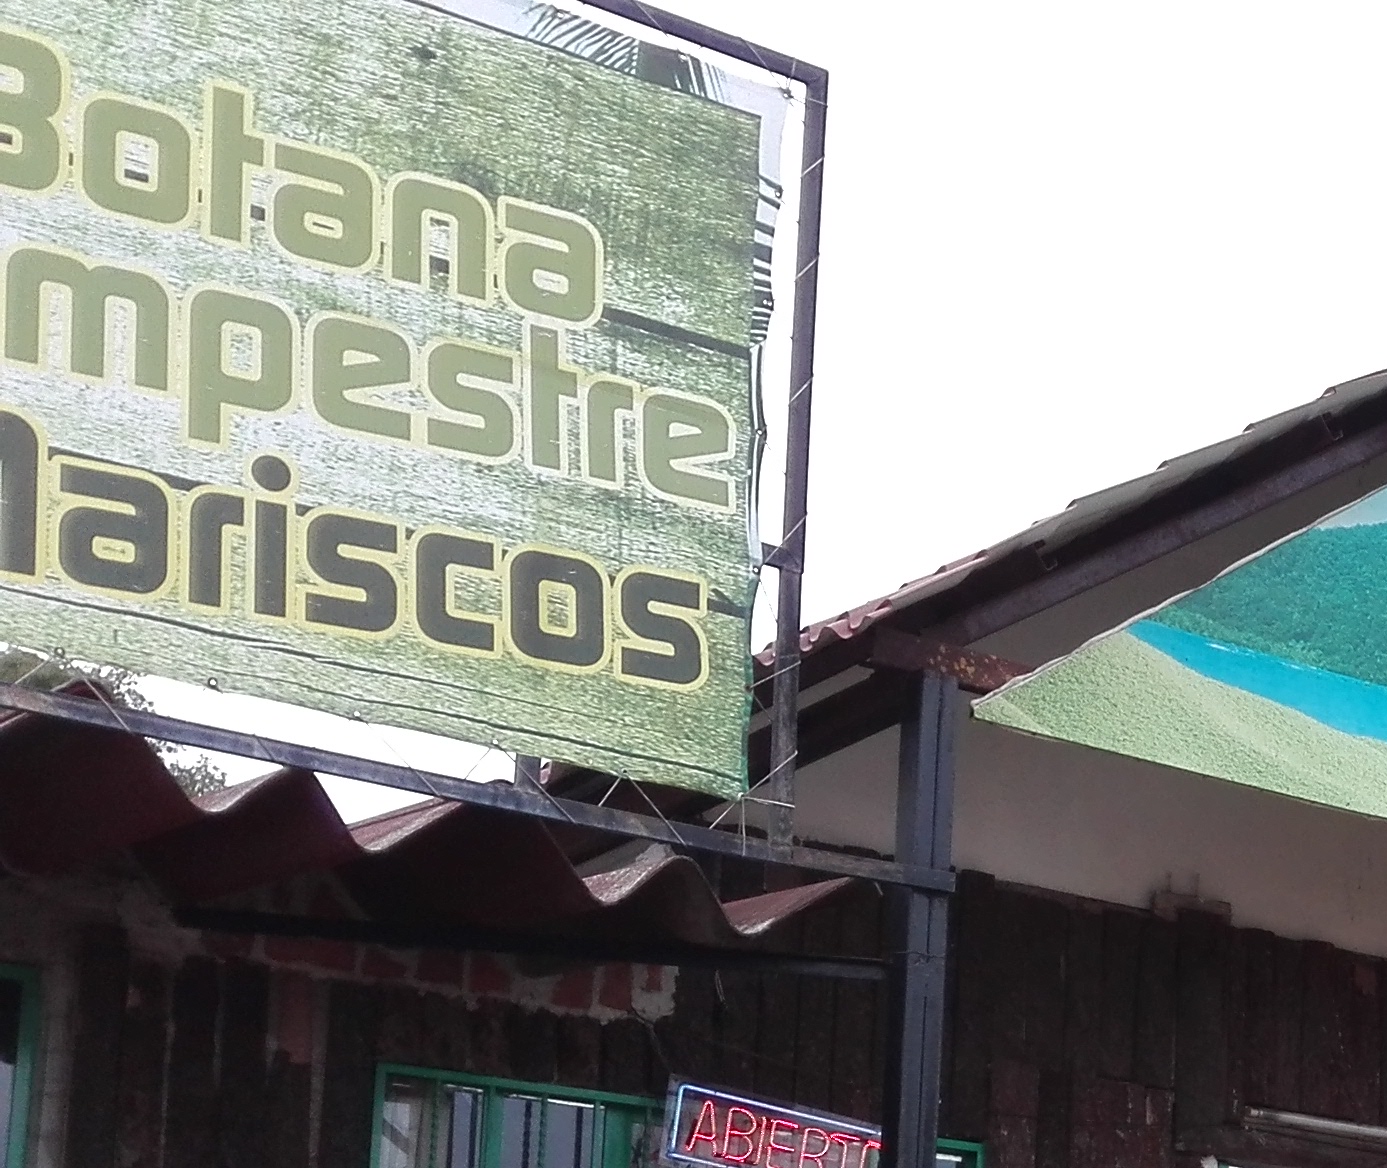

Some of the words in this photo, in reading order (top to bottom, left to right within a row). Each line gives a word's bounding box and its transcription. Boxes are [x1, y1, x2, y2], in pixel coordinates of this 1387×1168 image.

[0, 28, 602, 326] Botana
[0, 246, 734, 510] mpestre
[0, 411, 708, 690] ariscos
